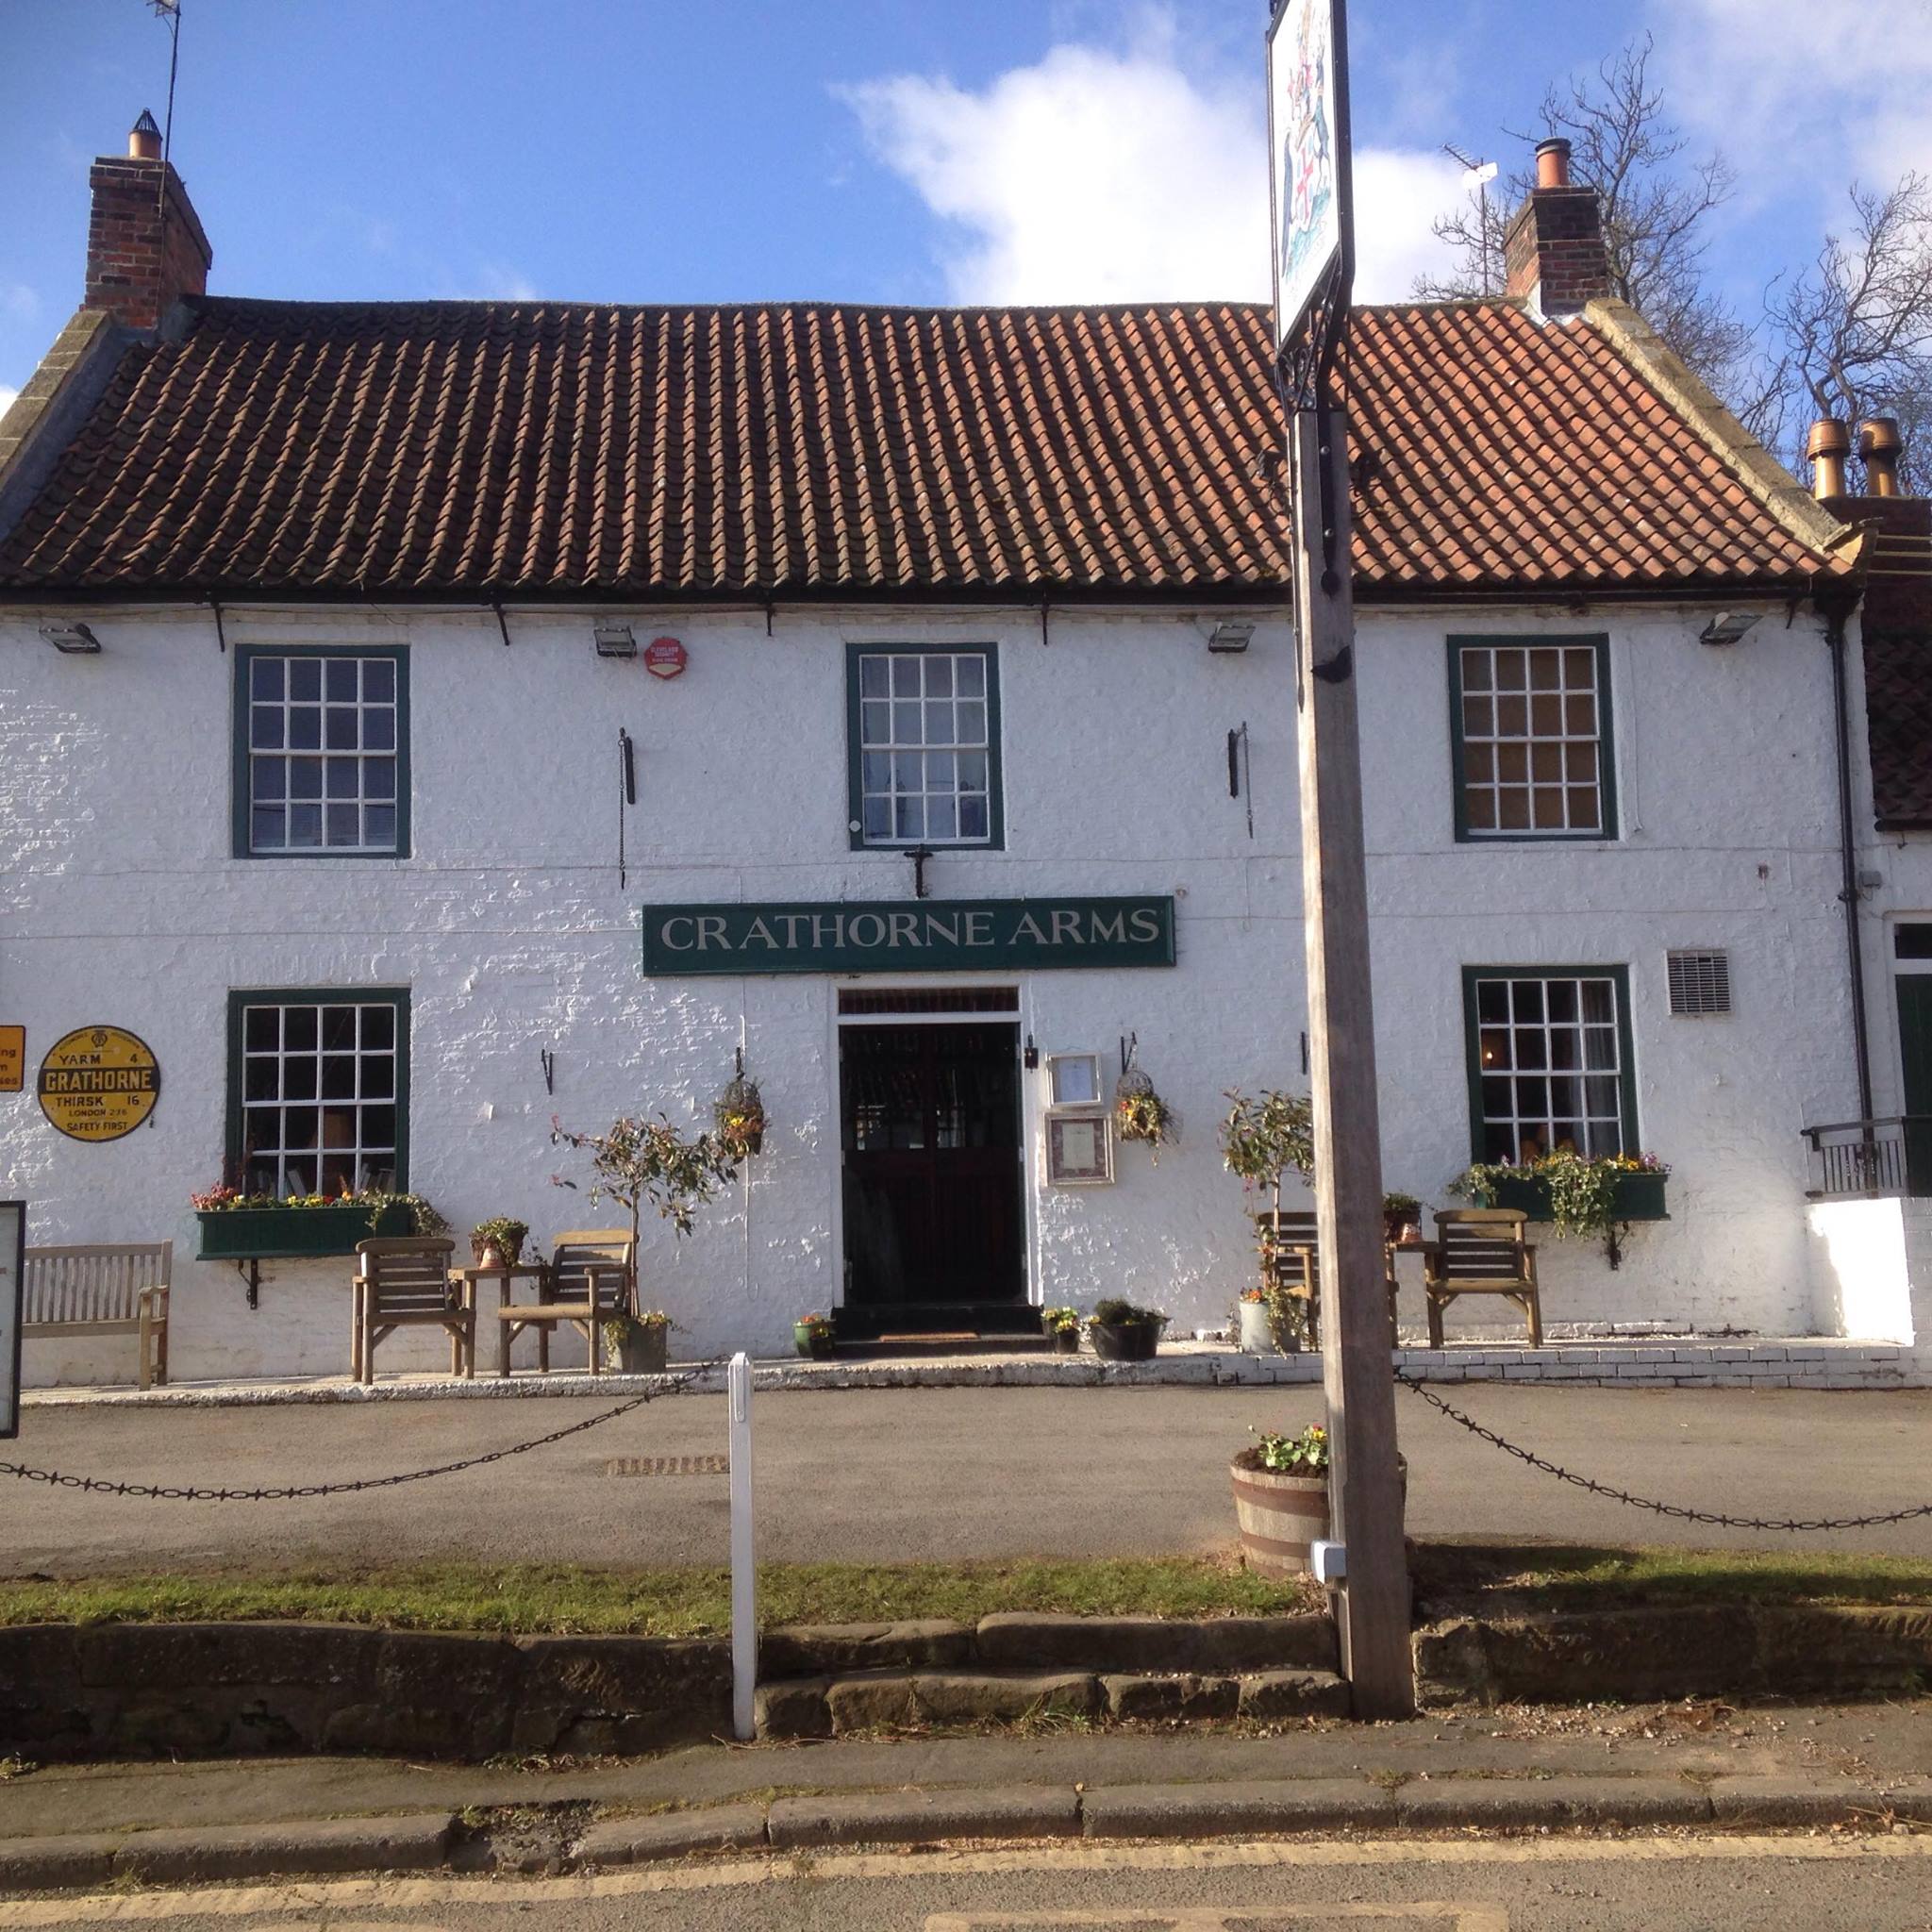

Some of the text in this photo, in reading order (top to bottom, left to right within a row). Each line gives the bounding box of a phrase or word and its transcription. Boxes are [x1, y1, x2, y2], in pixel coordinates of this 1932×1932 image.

[660, 908, 1160, 951] CRATHORNE ARMS
[59, 1053, 138, 1065] YARM 4
[56, 1094, 140, 1107] THIRSK 16
[69, 1108, 106, 1118] LONDON
[67, 1121, 128, 1132] SAFETY FIRST
